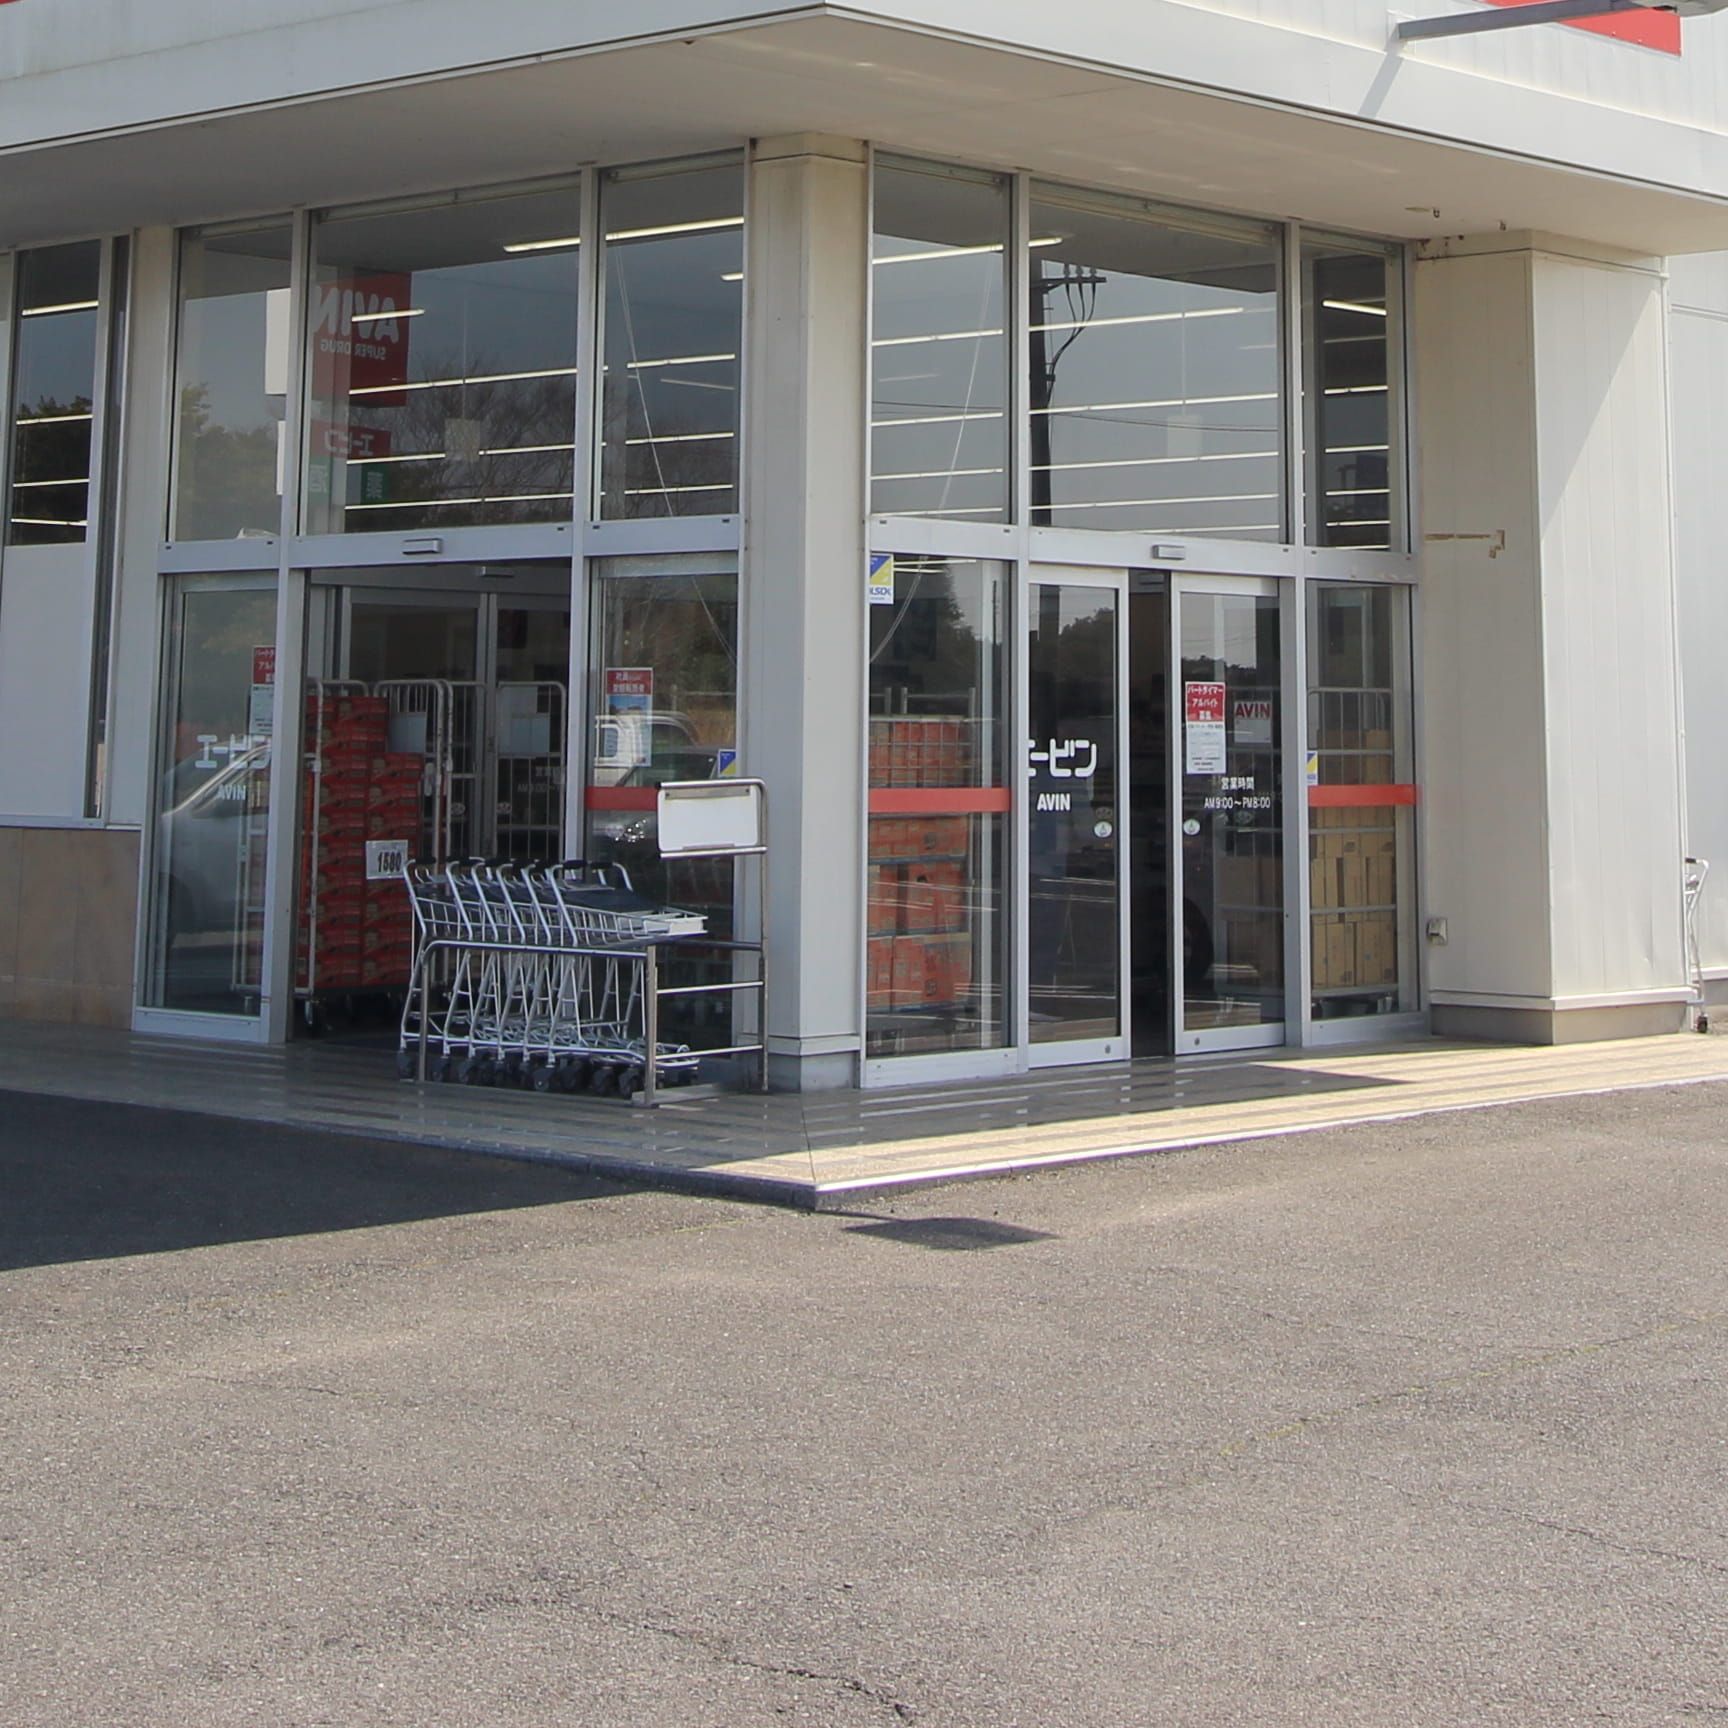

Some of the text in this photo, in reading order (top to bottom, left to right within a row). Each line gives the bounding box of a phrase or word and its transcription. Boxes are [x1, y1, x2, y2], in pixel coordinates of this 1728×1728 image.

[1235, 703, 1271, 719] AVIN
[1221, 776, 1255, 790] 営業時間
[216, 784, 246, 801] AVIN
[1037, 793, 1071, 811] AVIN
